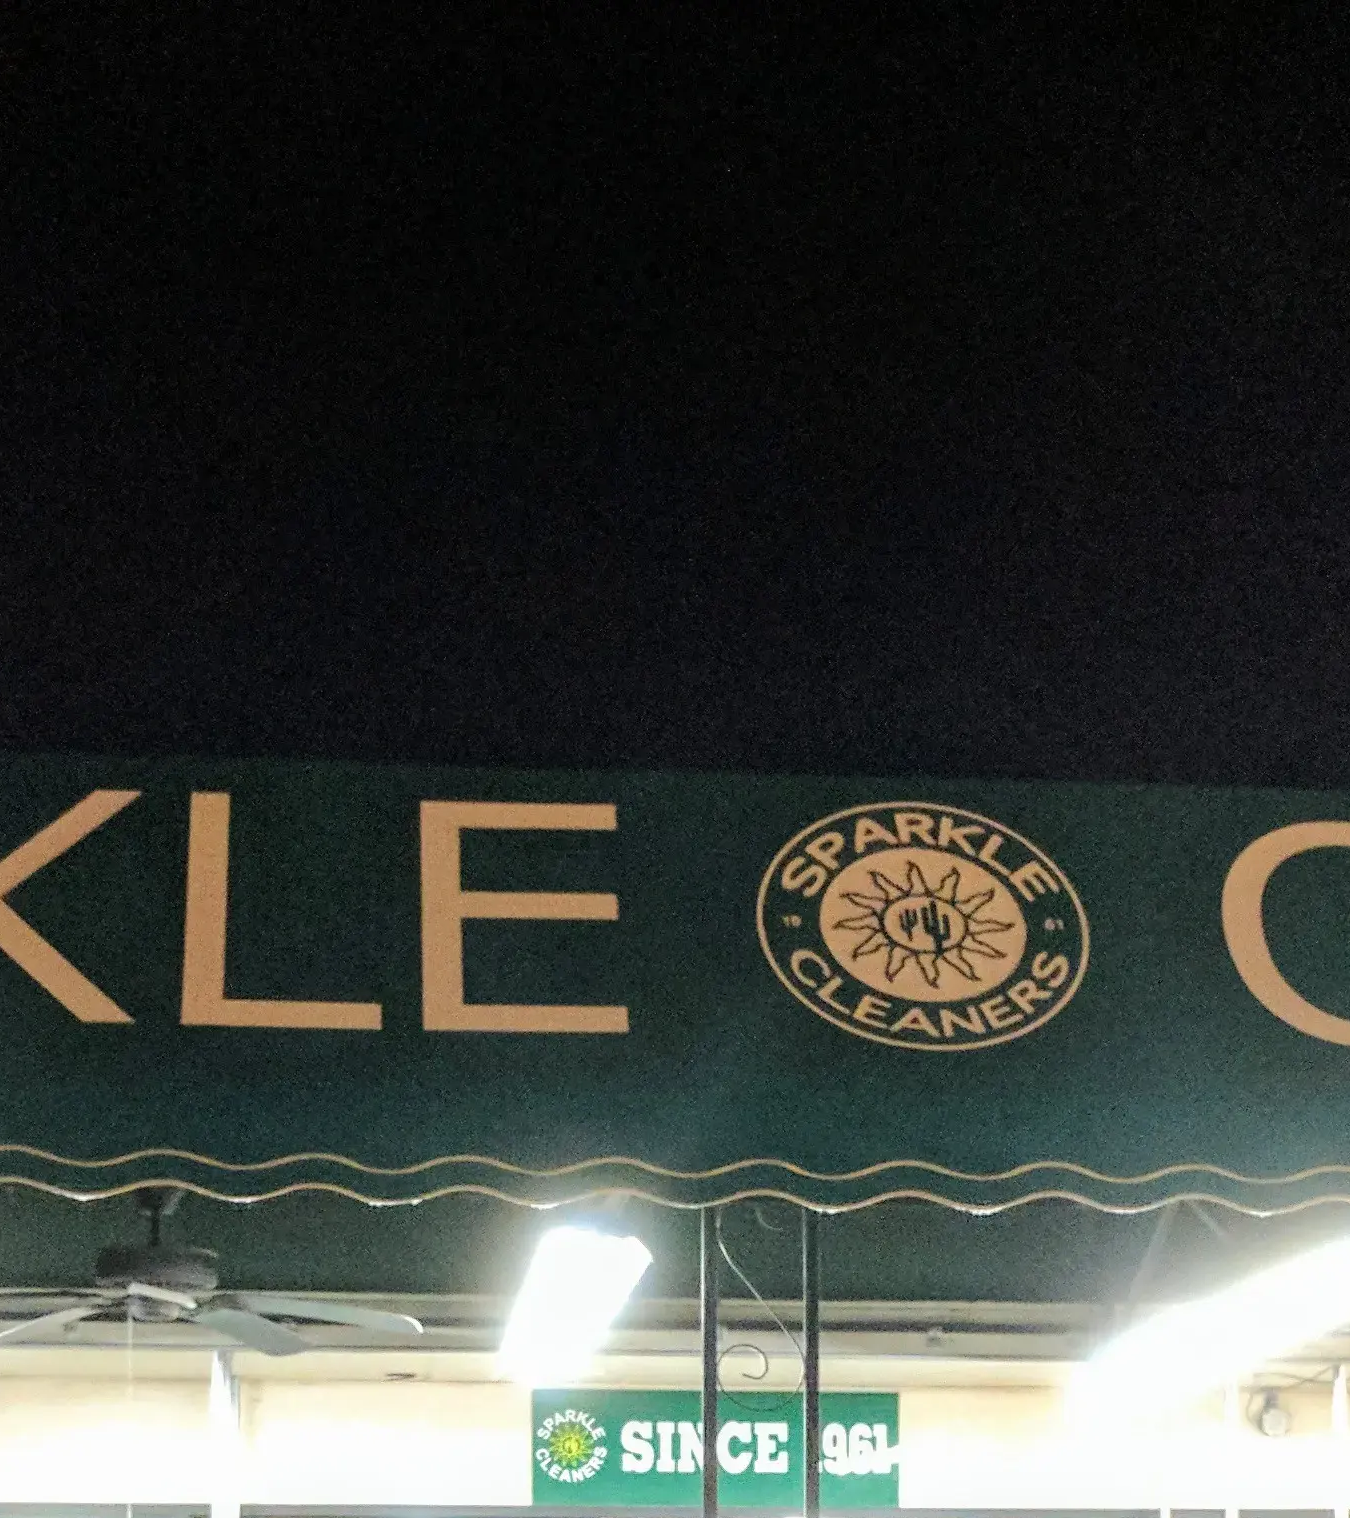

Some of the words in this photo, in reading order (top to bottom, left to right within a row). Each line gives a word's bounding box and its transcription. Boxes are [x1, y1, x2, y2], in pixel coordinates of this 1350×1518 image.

[781, 811, 1061, 901] SPARKLE
[790, 949, 1070, 1038] CLEANERS
[536, 1409, 607, 1440] SPARKLE
[619, 1420, 789, 1475] SINCE
[811, 1422, 893, 1476] 961
[535, 1446, 608, 1483] CLEANERS
